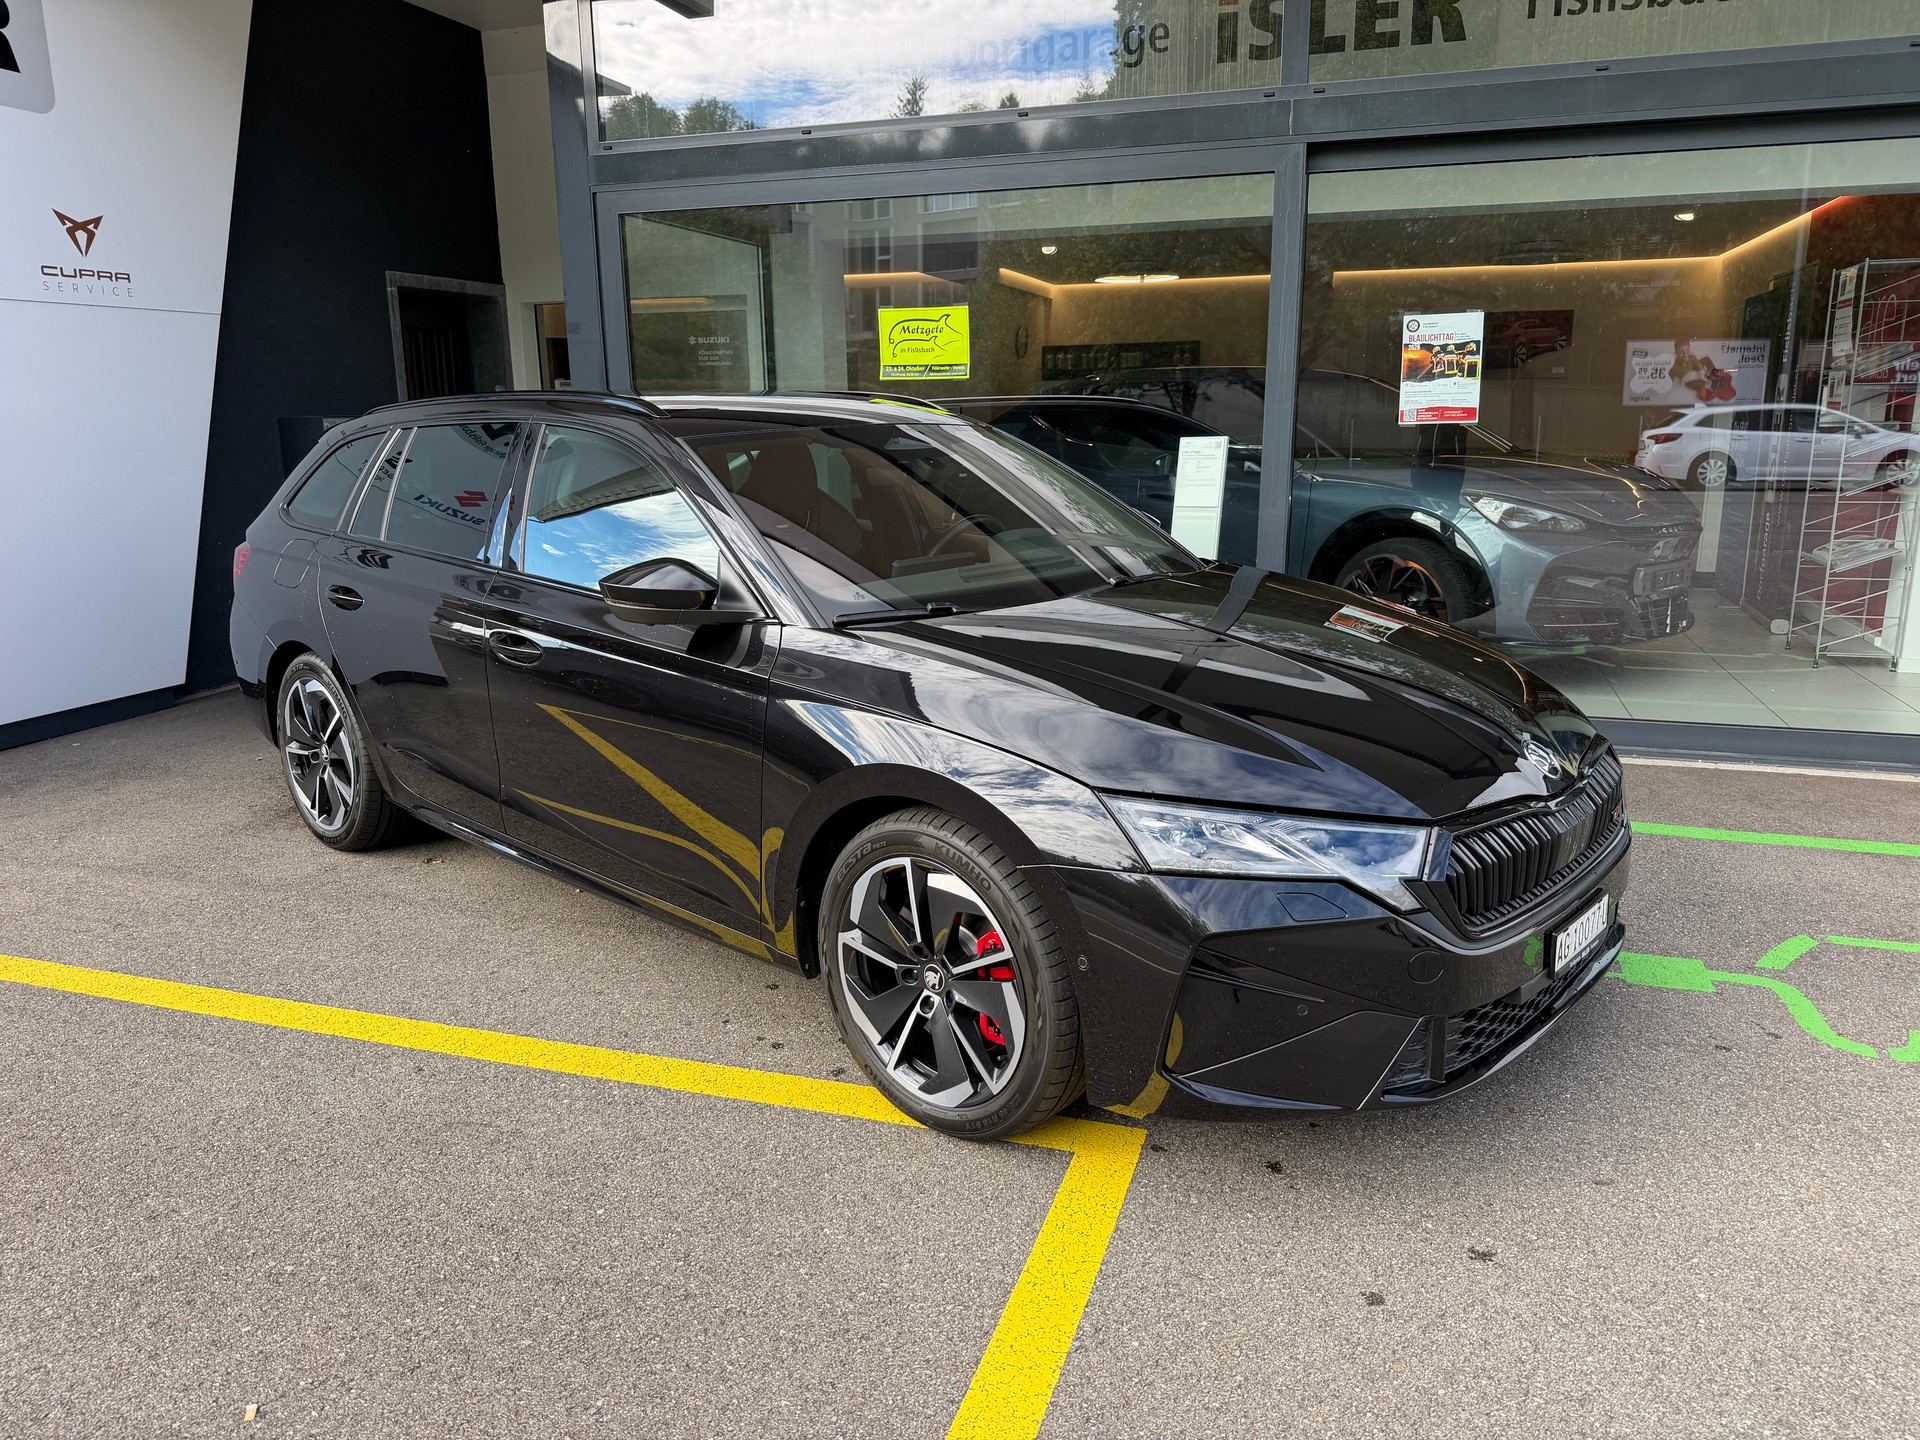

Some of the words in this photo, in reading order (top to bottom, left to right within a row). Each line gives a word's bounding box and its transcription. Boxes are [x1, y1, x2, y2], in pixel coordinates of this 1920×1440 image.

[40, 265, 131, 283] CUPRA
[42, 281, 133, 297] SERVICE
[899, 325, 944, 336] Metzgete
[697, 336, 730, 344] SUZUKI
[1408, 332, 1454, 343] BLAULICHTTAG
[934, 842, 992, 892] KUMHO
